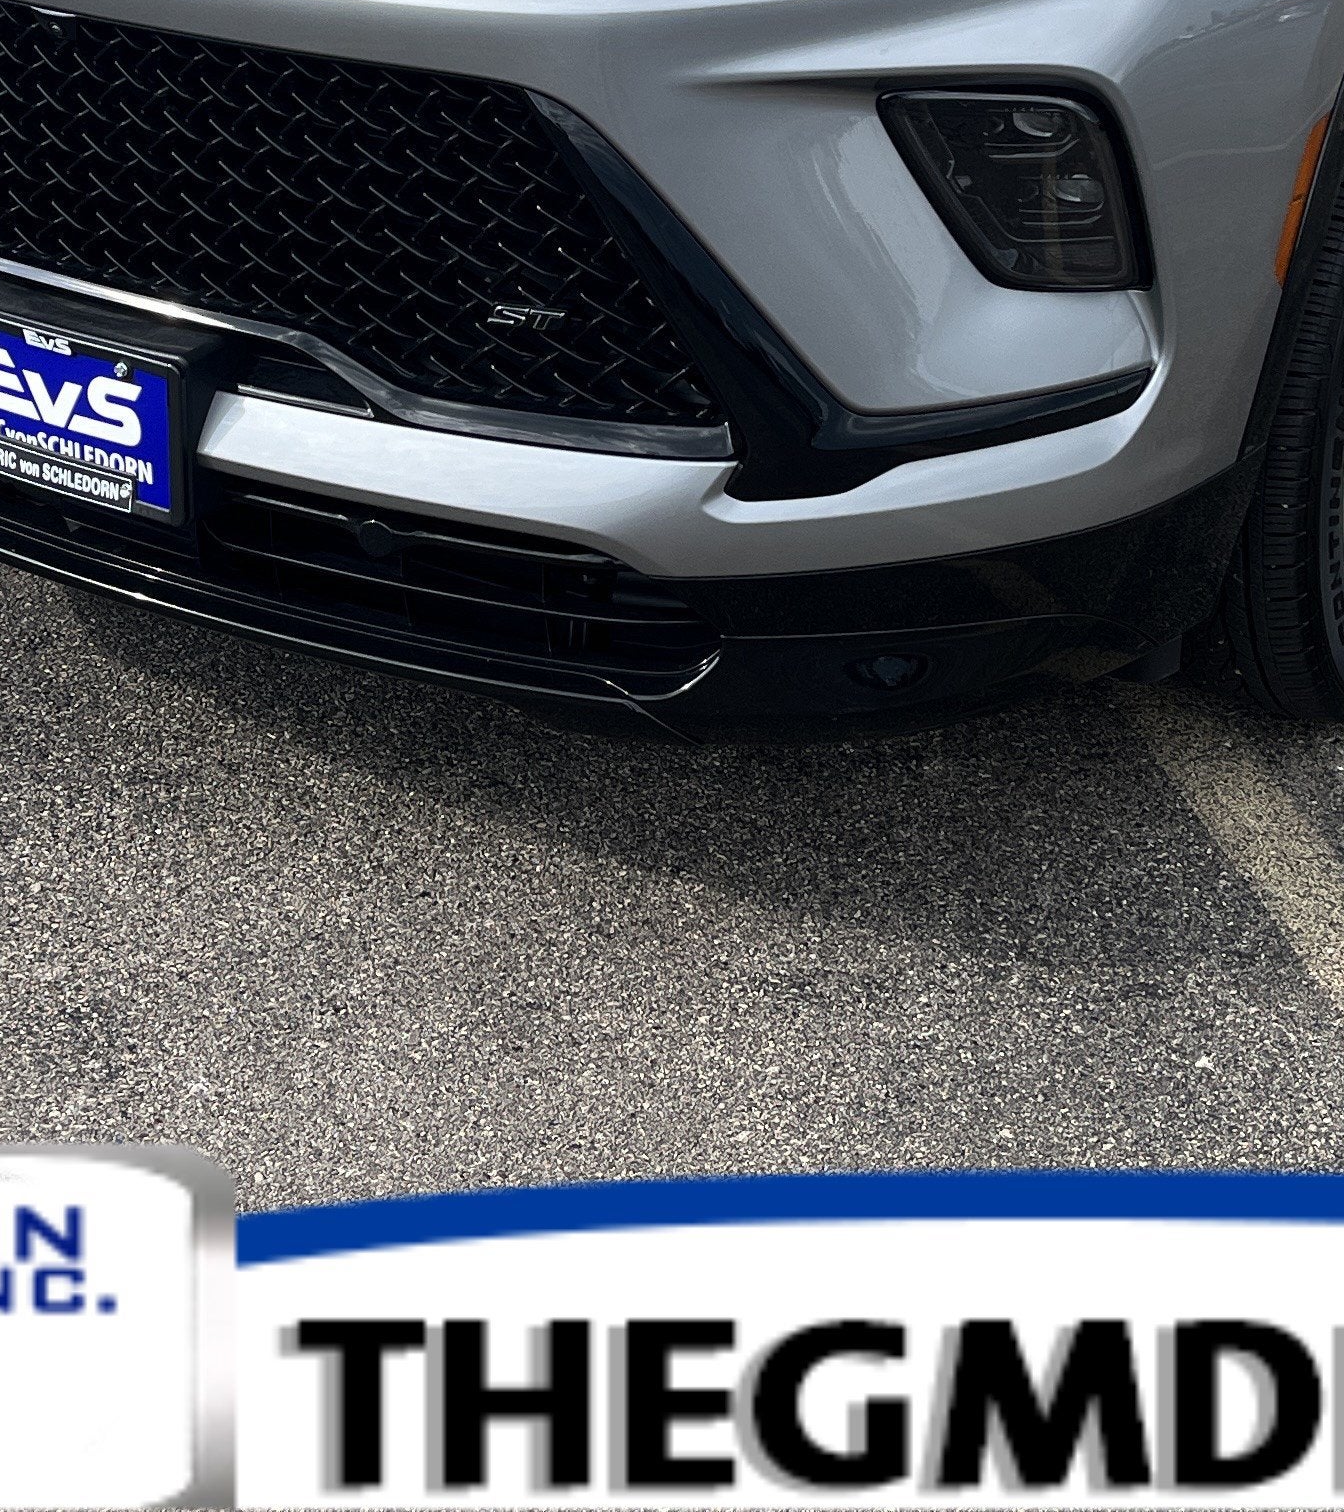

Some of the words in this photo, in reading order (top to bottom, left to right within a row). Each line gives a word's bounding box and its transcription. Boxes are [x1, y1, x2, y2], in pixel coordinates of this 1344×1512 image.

[486, 305, 566, 330] ST
[19, 458, 40, 478] von
[42, 462, 119, 500] SCHLEDORN
